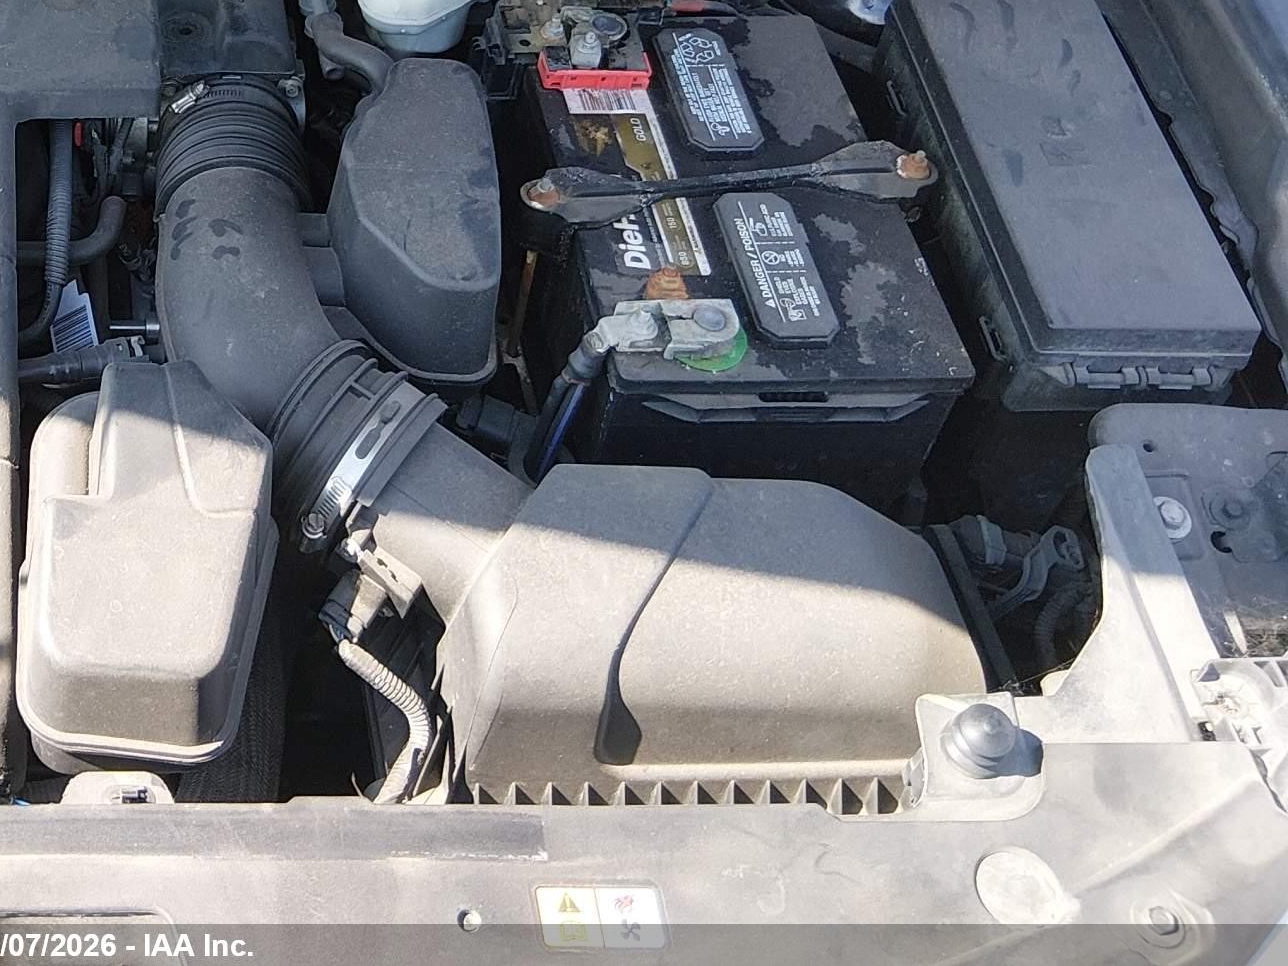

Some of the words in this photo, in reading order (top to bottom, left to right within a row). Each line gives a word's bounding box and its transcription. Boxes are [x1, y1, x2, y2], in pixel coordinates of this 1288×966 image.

[630, 117, 646, 142] GOLD
[613, 213, 652, 270] DieH
[733, 218, 755, 251] POISON
[750, 258, 772, 298] DANGER
